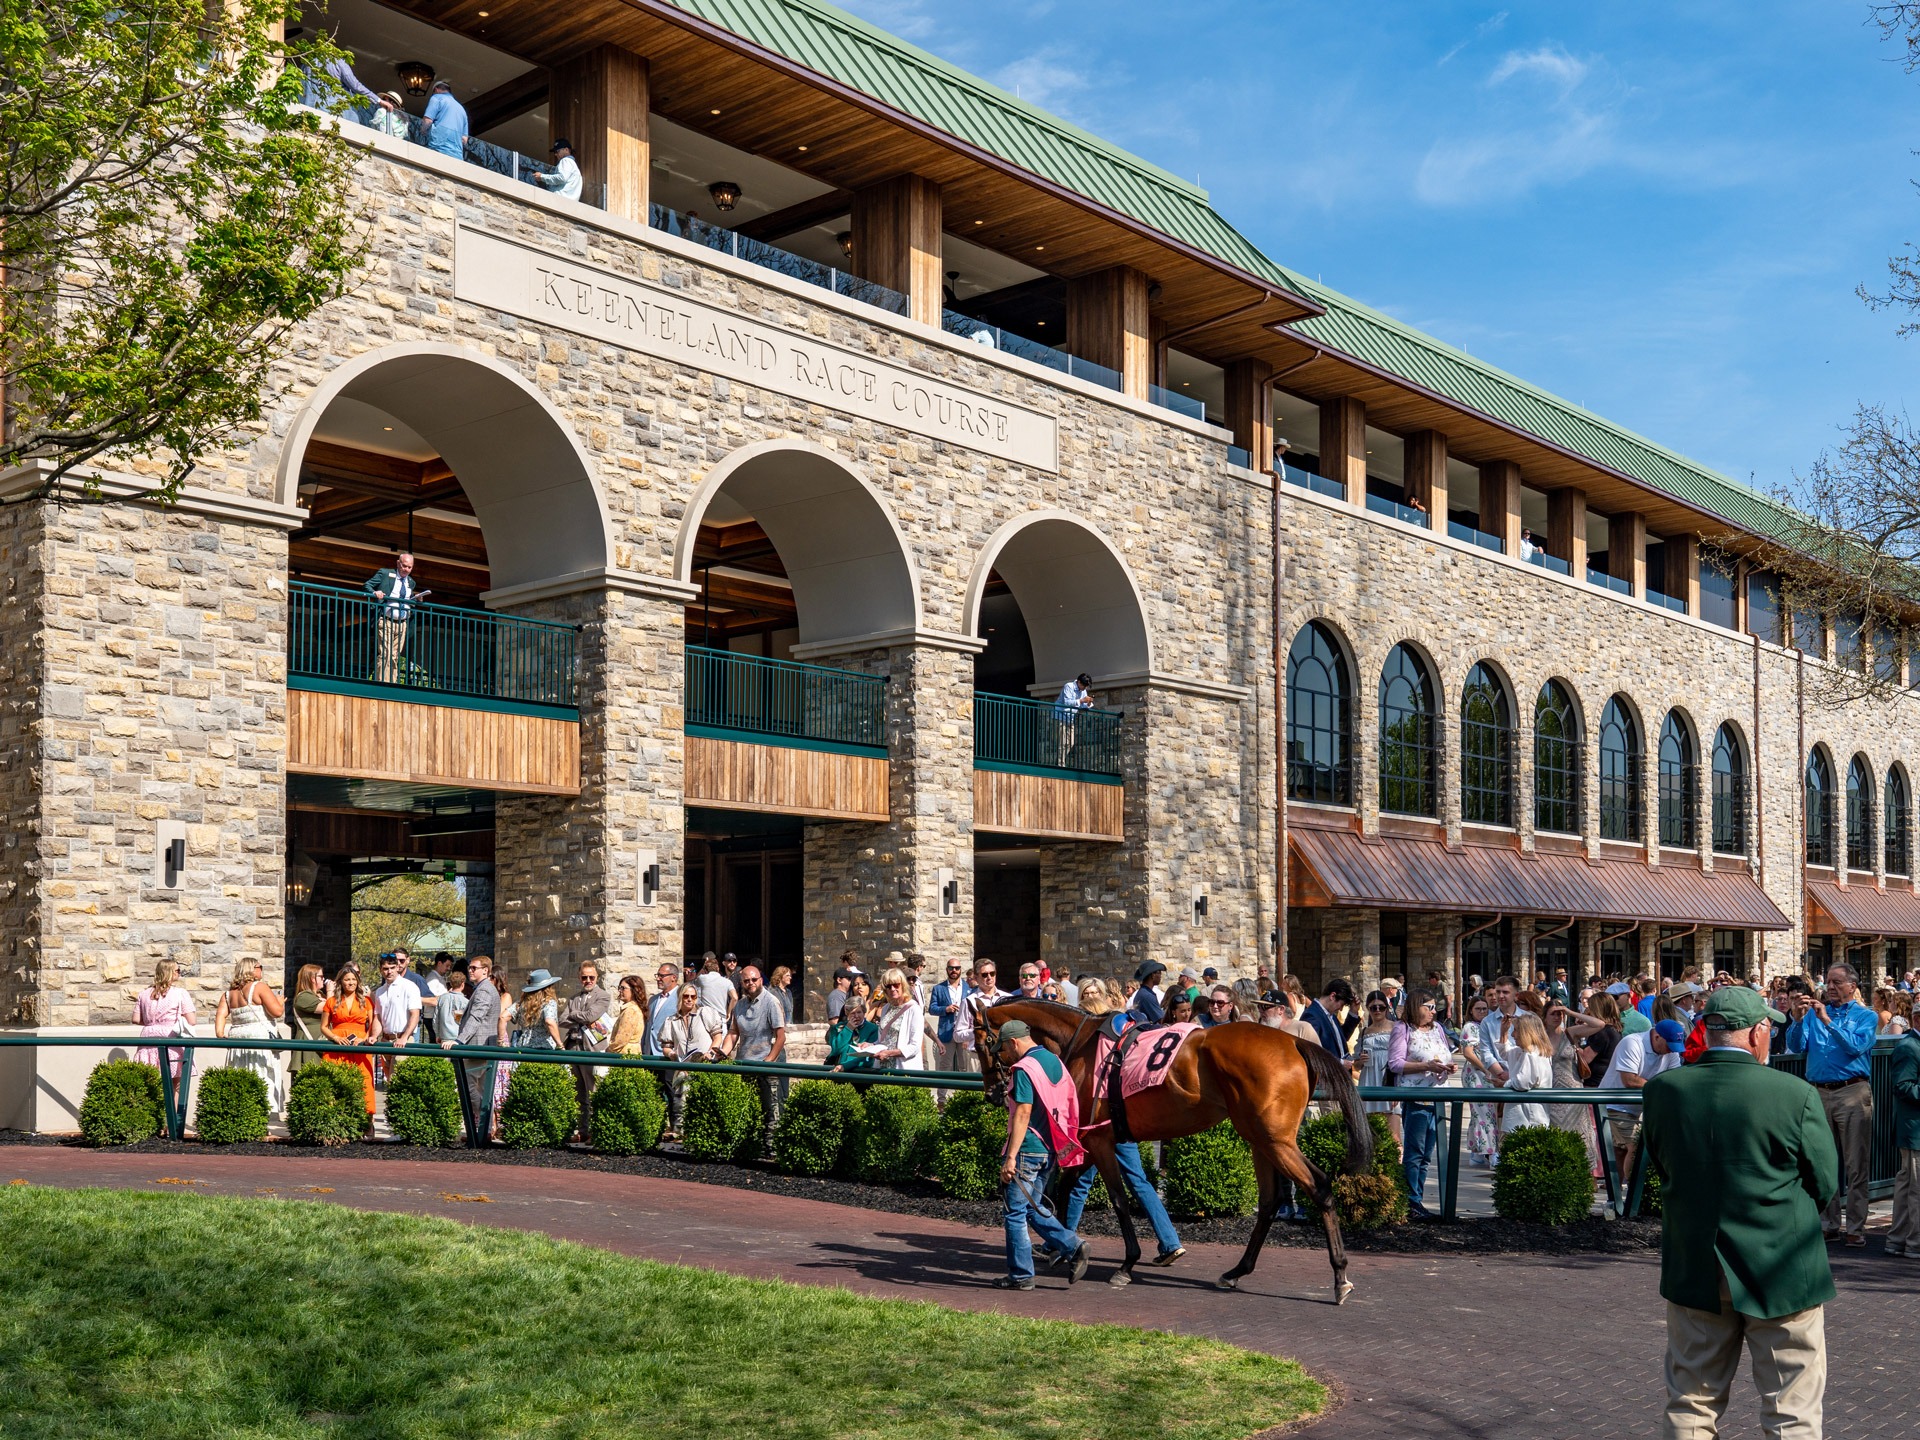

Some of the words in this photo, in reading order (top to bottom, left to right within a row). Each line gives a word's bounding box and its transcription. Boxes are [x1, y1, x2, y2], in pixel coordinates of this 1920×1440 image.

[536, 267, 778, 371] KEENELAND
[790, 348, 877, 402] RACE
[891, 381, 1009, 443] COURSE
[1146, 1032, 1181, 1072] 8
